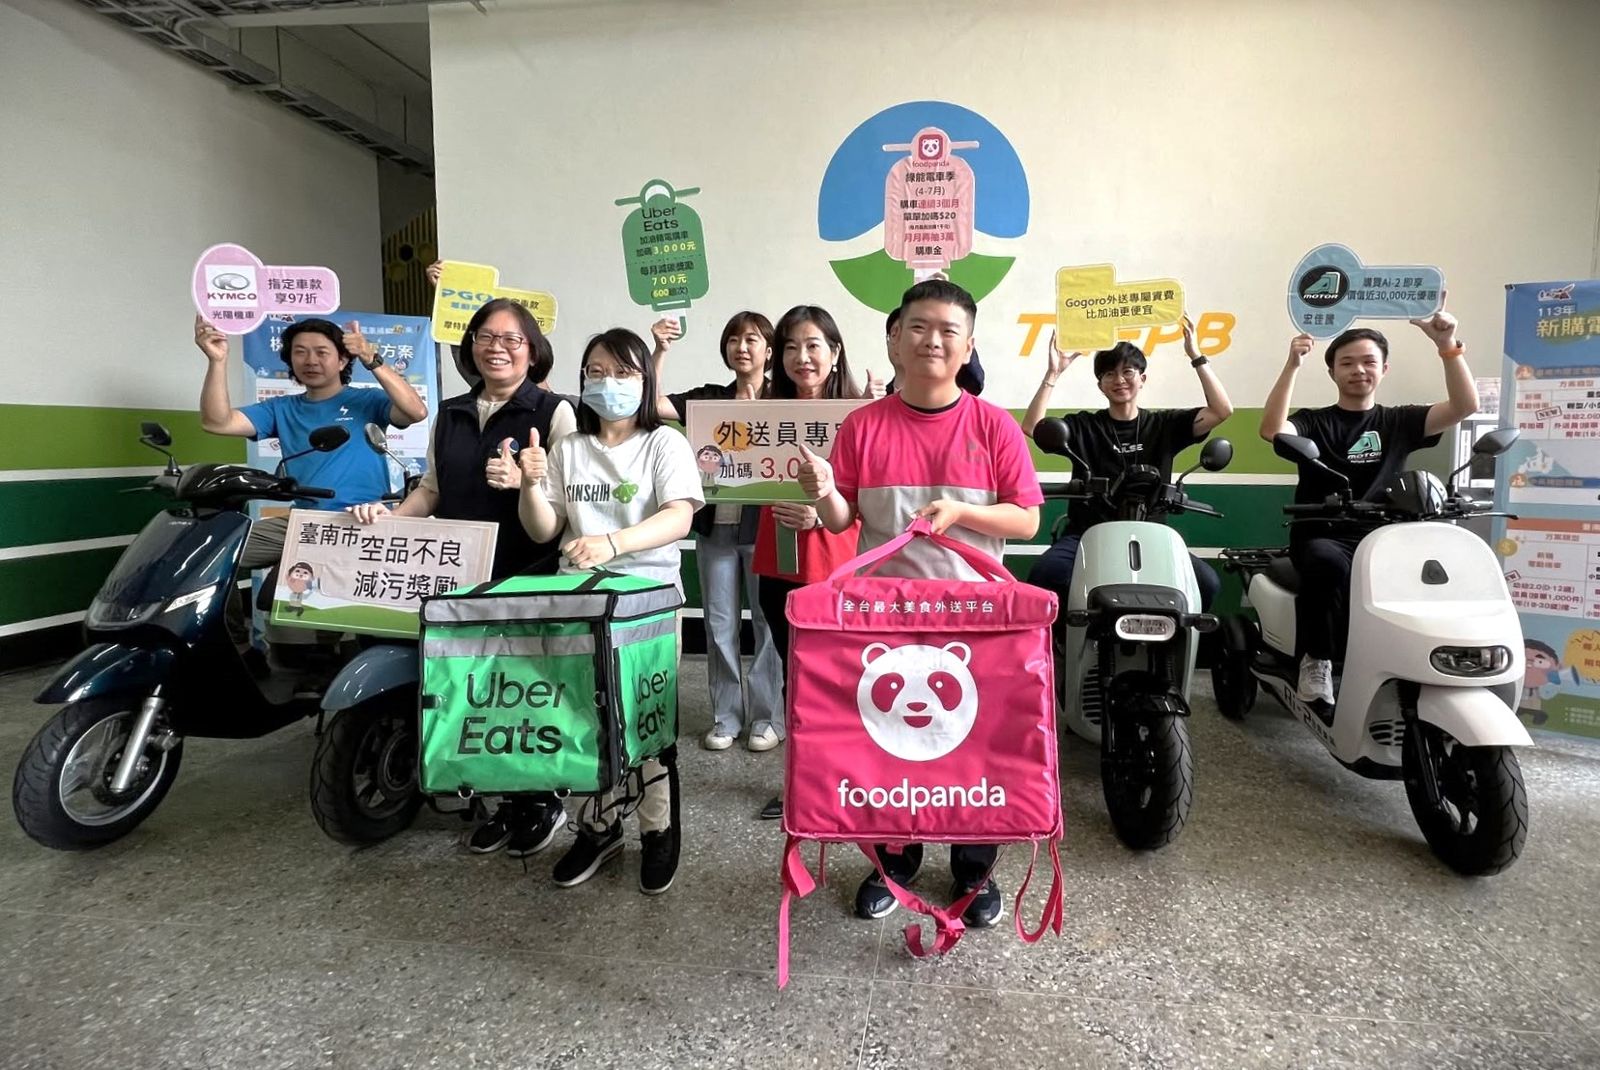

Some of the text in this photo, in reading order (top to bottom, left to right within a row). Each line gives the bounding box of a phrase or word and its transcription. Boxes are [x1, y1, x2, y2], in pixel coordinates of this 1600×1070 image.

[912, 160, 949, 168] foodpanda
[905, 171, 955, 183] 綠能電車季
[915, 185, 946, 197] (4-7月)
[641, 206, 677, 219] Uber
[643, 218, 679, 232] Eats
[268, 278, 322, 290] 指定車款
[651, 273, 687, 286] 700元
[207, 292, 257, 300] KYMCO
[275, 292, 318, 304] 享97折
[441, 288, 494, 302] PGO
[212, 310, 255, 320] 光陽機車
[1086, 304, 1153, 319] 比加油更便宜
[1538, 304, 1577, 317] 113年
[717, 420, 842, 447] 外送員專
[719, 462, 753, 479] 加碼
[298, 522, 362, 547] 臺南市
[358, 535, 462, 568] 空品不良
[842, 600, 995, 614] 全台最大美食外送平台
[466, 671, 567, 709] Uber
[631, 669, 668, 705] Uber
[456, 716, 563, 755] Eats
[837, 777, 1006, 816] foodpanda
